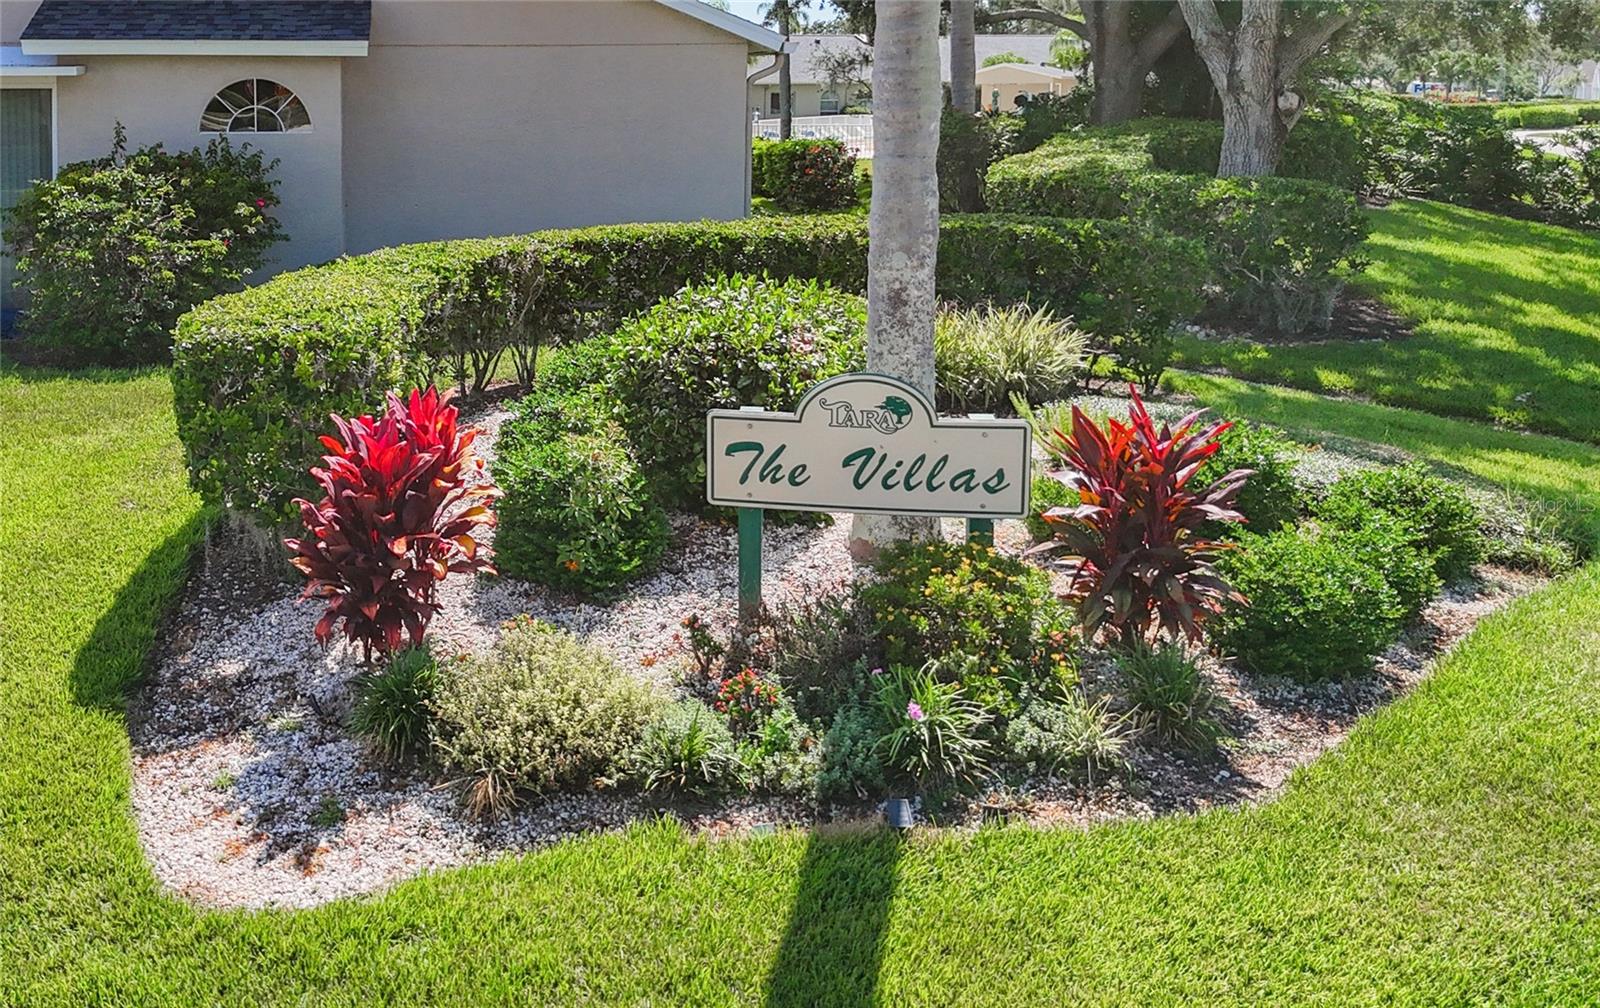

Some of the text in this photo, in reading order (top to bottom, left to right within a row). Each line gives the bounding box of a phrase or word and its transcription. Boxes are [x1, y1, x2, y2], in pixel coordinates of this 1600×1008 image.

[819, 398, 898, 435] TARA
[724, 441, 1011, 495] The Villas
